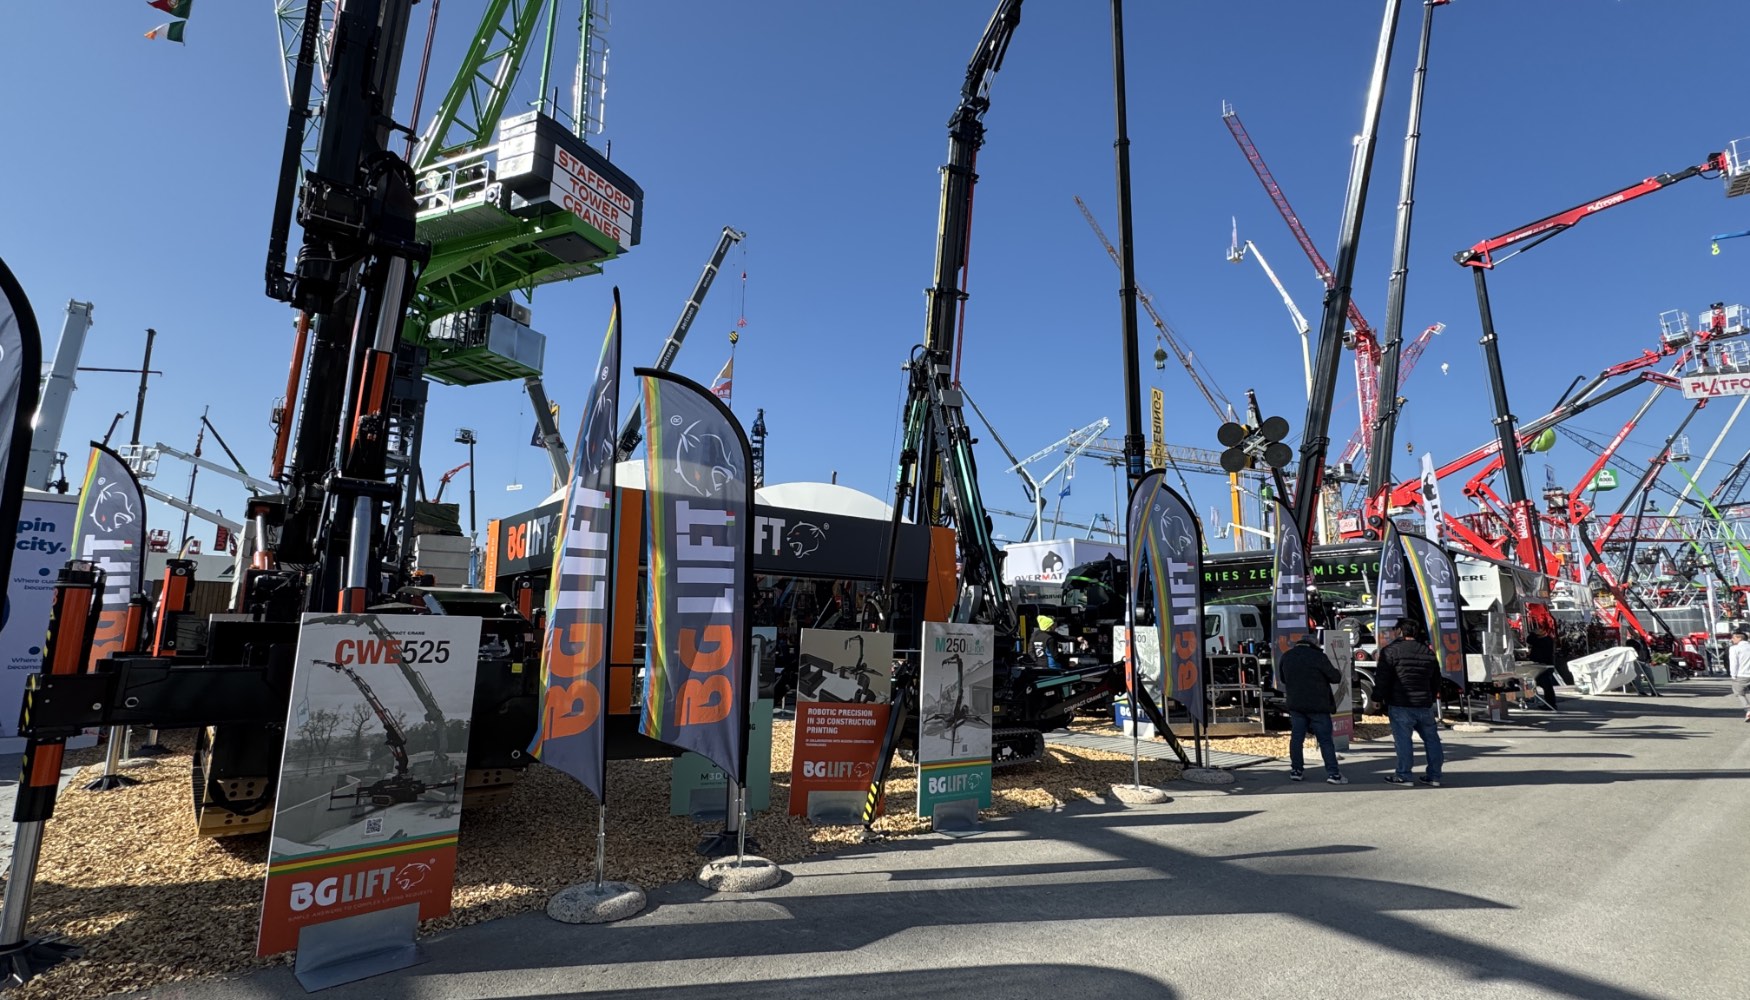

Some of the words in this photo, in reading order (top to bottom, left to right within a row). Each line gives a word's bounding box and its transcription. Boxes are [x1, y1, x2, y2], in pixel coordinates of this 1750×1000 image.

[558, 149, 631, 211] STAFFORD
[569, 176, 619, 223] TOWER
[562, 194, 621, 241] CRANES
[507, 523, 526, 561] BG
[525, 514, 551, 558] LIFT
[556, 475, 610, 610] LIFT
[675, 500, 736, 614] LIFT
[1014, 572, 1064, 581] OVERMAT
[1166, 557, 1197, 626] LIFT
[1277, 570, 1307, 629] LIFT
[1430, 584, 1458, 629] LIFT
[335, 639, 451, 665] CWE525
[935, 637, 966, 653] M250
[1175, 630, 1198, 692] BG
[1443, 633, 1461, 672] BG
[543, 622, 604, 741] BG
[674, 624, 734, 727] BG
[806, 726, 838, 734] PRINTING
[807, 717, 814, 725] IN
[826, 718, 877, 726] CONSTRUCTION
[808, 708, 837, 716] ROBOTIC
[838, 709, 873, 717] PRECISION
[803, 760, 826, 778] BG
[827, 761, 854, 778] LIFT
[928, 776, 947, 795] BG
[947, 774, 968, 793] LIFT
[289, 876, 338, 911] BG
[341, 866, 396, 903] LIFT
